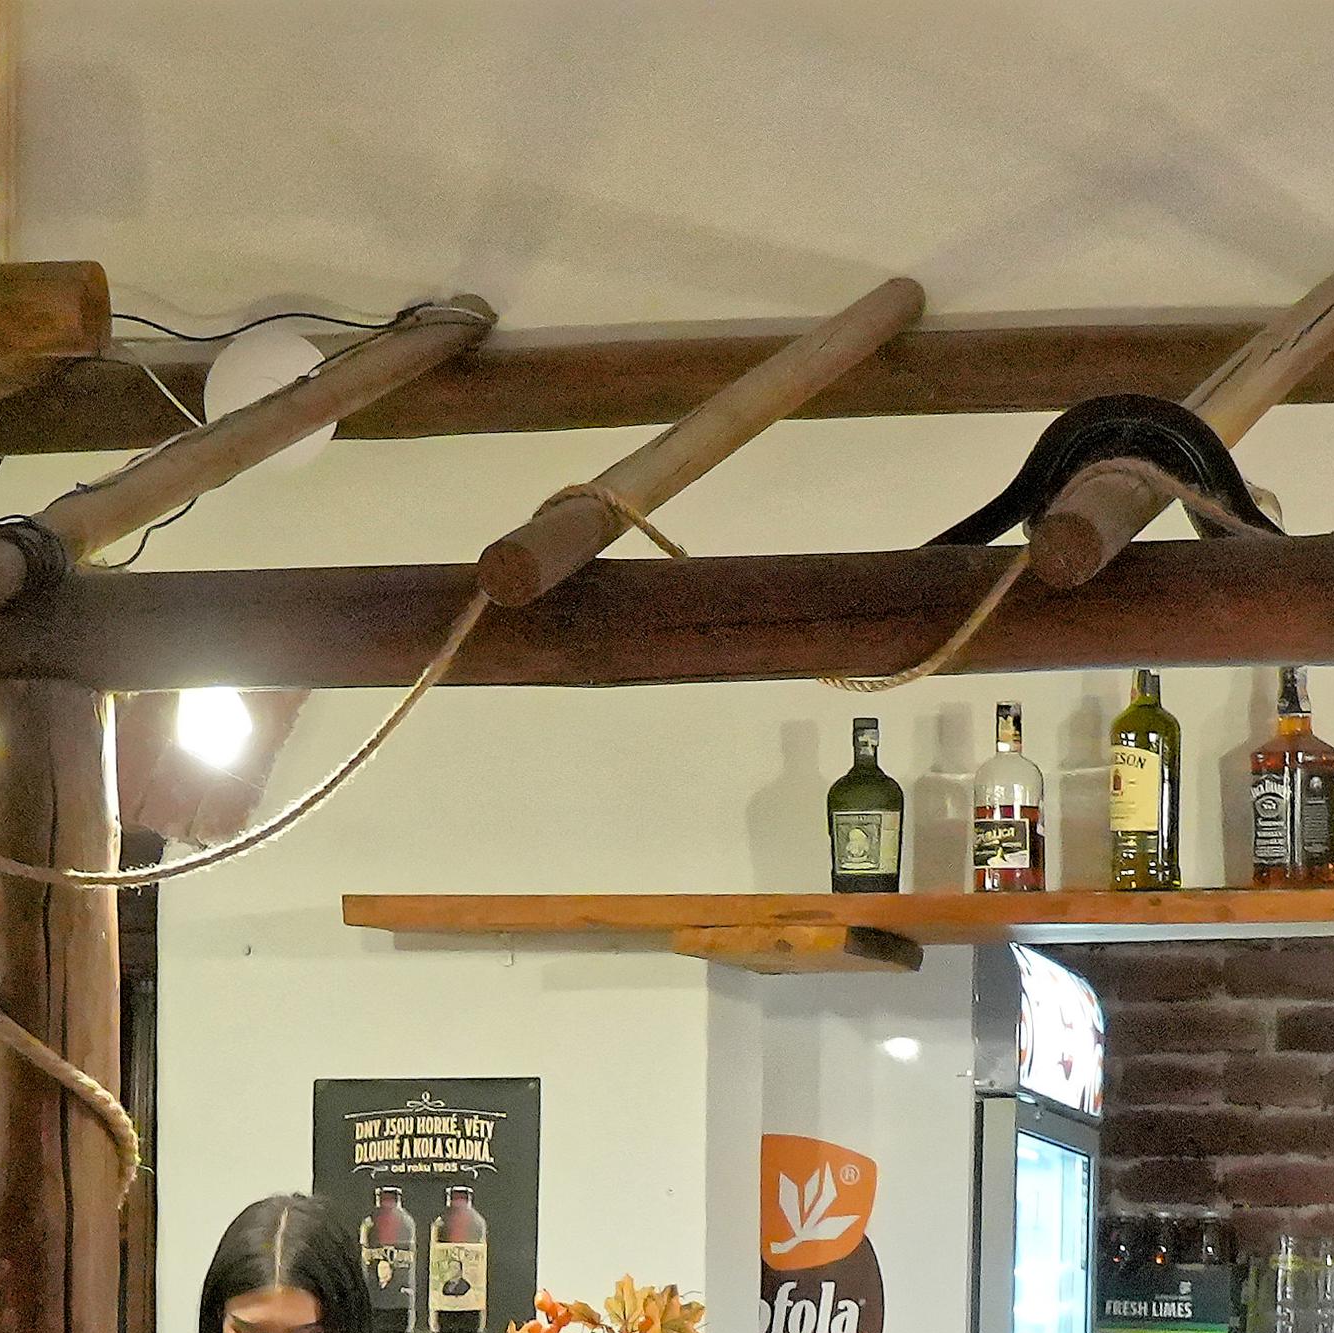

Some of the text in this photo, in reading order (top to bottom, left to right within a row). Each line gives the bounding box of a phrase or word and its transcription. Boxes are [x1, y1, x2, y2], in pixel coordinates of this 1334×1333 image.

[383, 1116, 415, 1137] JSOU
[416, 1113, 462, 1138] HORKÉ,
[354, 1135, 401, 1164] DLOUHÉ
[402, 1138, 412, 1159] A
[413, 1137, 444, 1158] KOLA
[390, 1162, 406, 1173] od
[1105, 1300, 1193, 1318] FRESH LIMES
